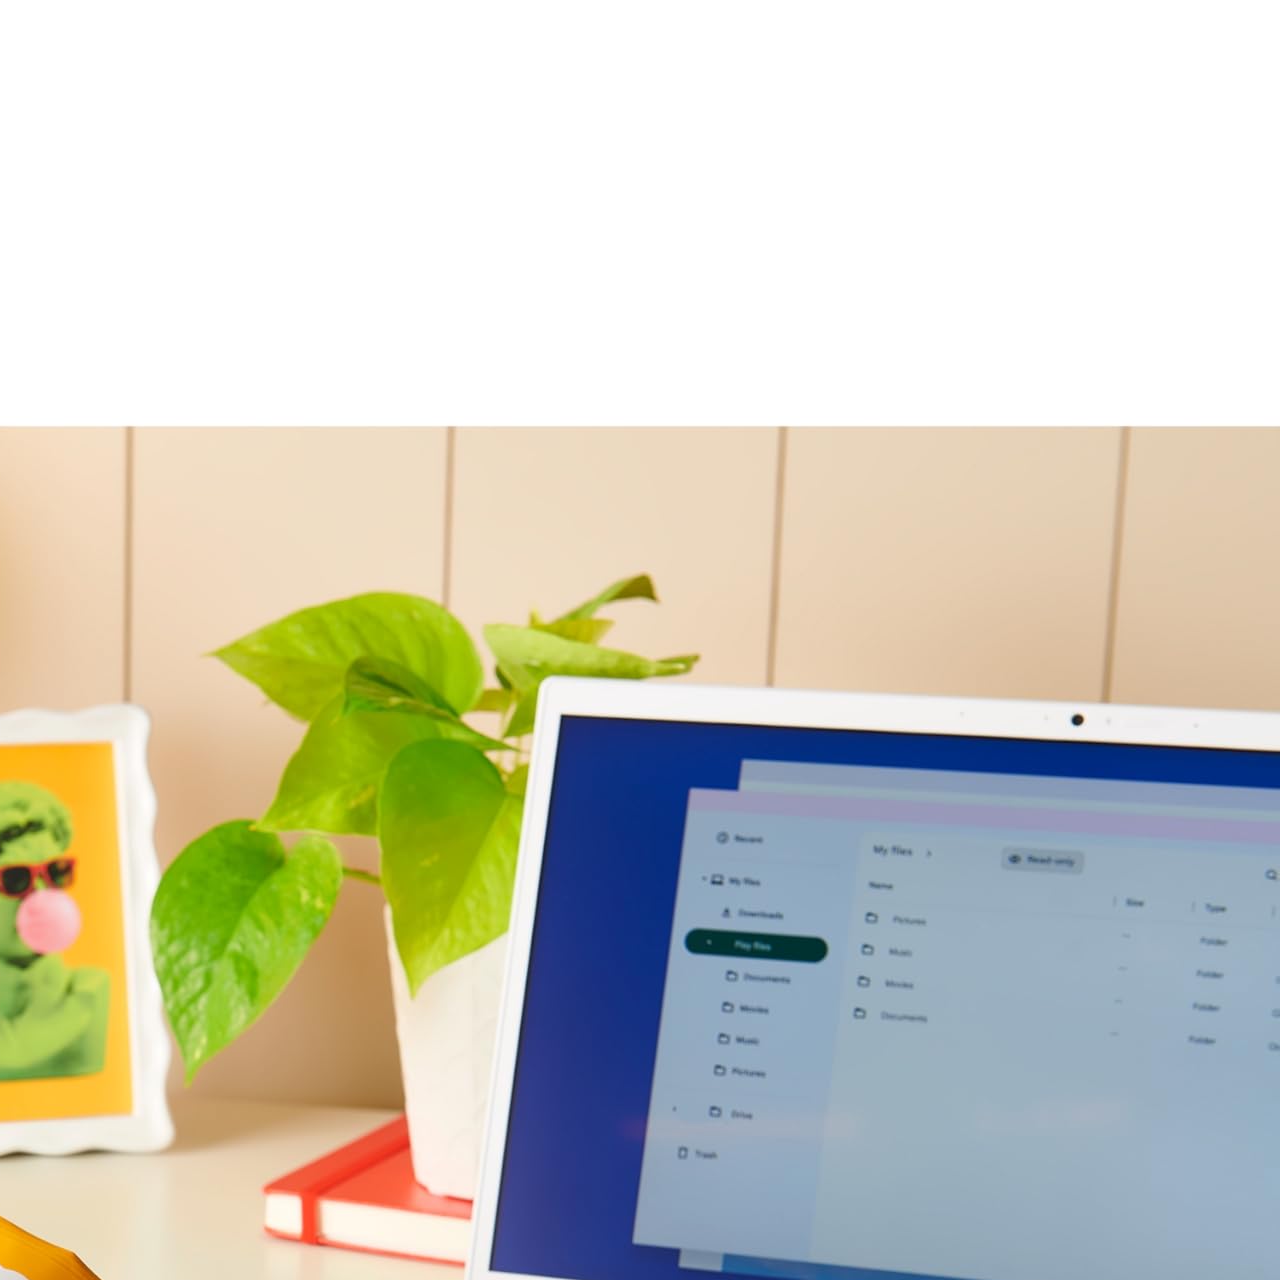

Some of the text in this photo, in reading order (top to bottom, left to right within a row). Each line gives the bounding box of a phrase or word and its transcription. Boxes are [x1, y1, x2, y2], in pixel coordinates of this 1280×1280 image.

[734, 834, 764, 844] Recent
[873, 845, 913, 856] My files
[1027, 856, 1075, 867] Read-only
[728, 877, 761, 886] My files
[868, 881, 894, 890] Name
[734, 940, 772, 951] Play files
